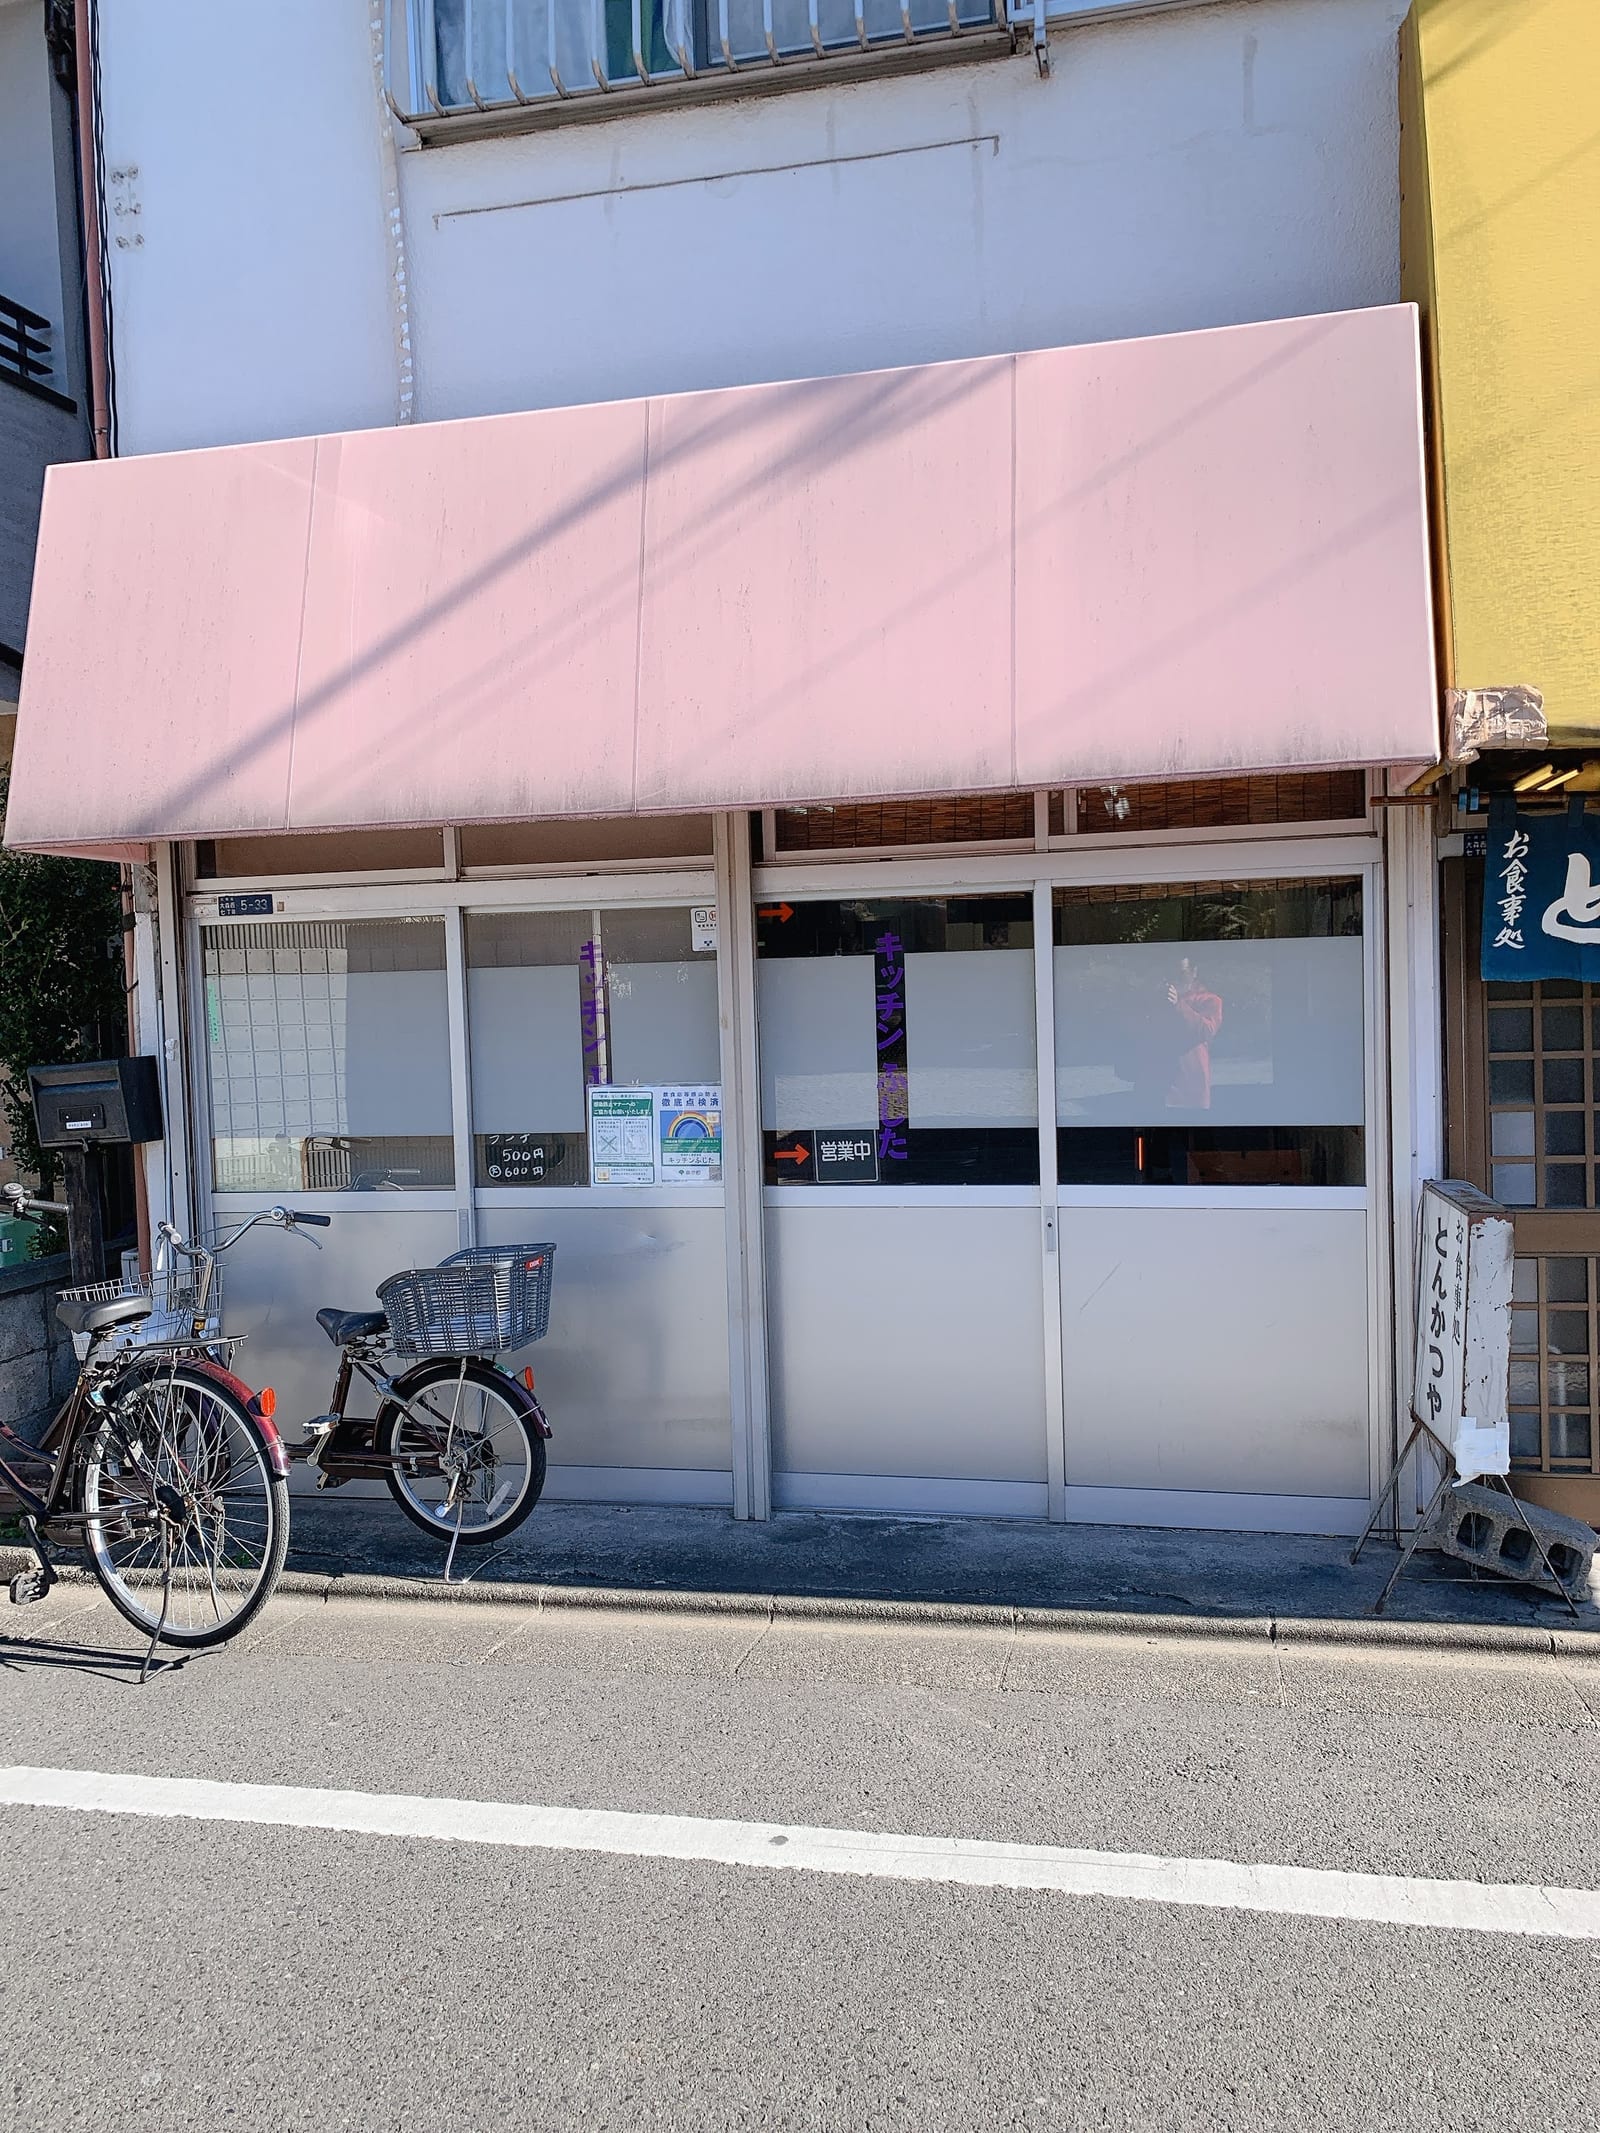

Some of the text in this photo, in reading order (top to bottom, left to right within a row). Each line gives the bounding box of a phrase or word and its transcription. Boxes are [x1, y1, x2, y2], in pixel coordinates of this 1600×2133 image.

[1492, 829, 1530, 950] お食事処
[240, 898, 268, 911] 5-33
[502, 1147, 544, 1162] 500円
[820, 1140, 871, 1162] 営業中
[1426, 1217, 1448, 1421] とんかつや
